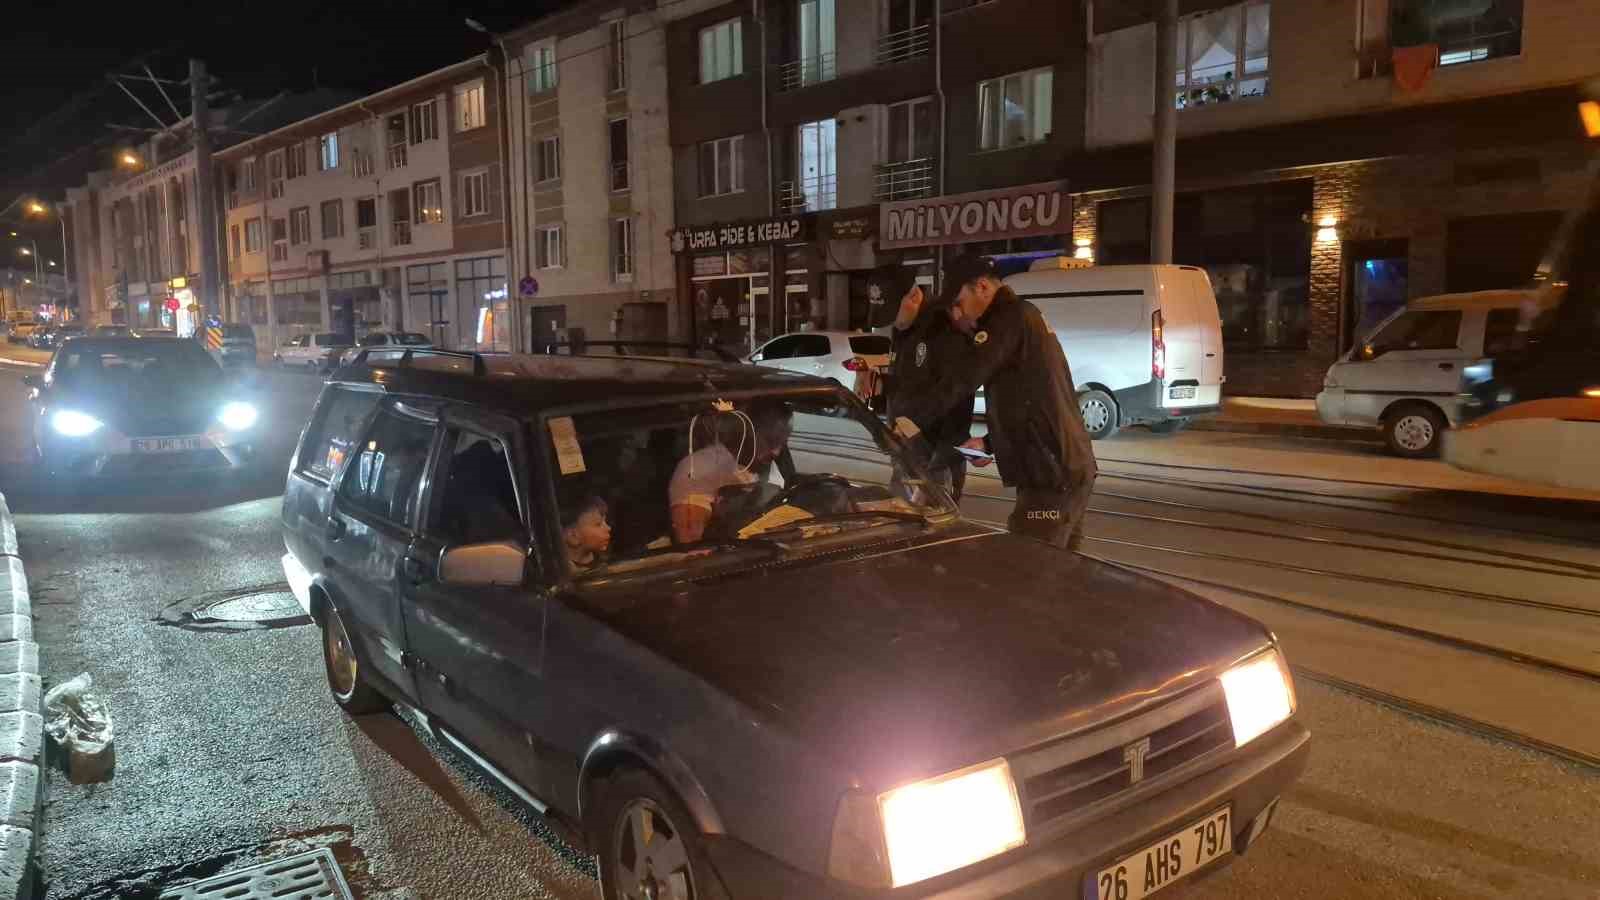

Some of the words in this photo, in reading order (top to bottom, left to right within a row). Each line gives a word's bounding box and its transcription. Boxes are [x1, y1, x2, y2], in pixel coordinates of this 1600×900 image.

[689, 230, 717, 249] URFA
[720, 224, 745, 246] PİDE
[747, 225, 755, 243] &
[758, 219, 800, 241] KEBAP
[1100, 866, 1128, 900] 26
[1144, 839, 1181, 891] AHS
[1194, 813, 1228, 865] 797
